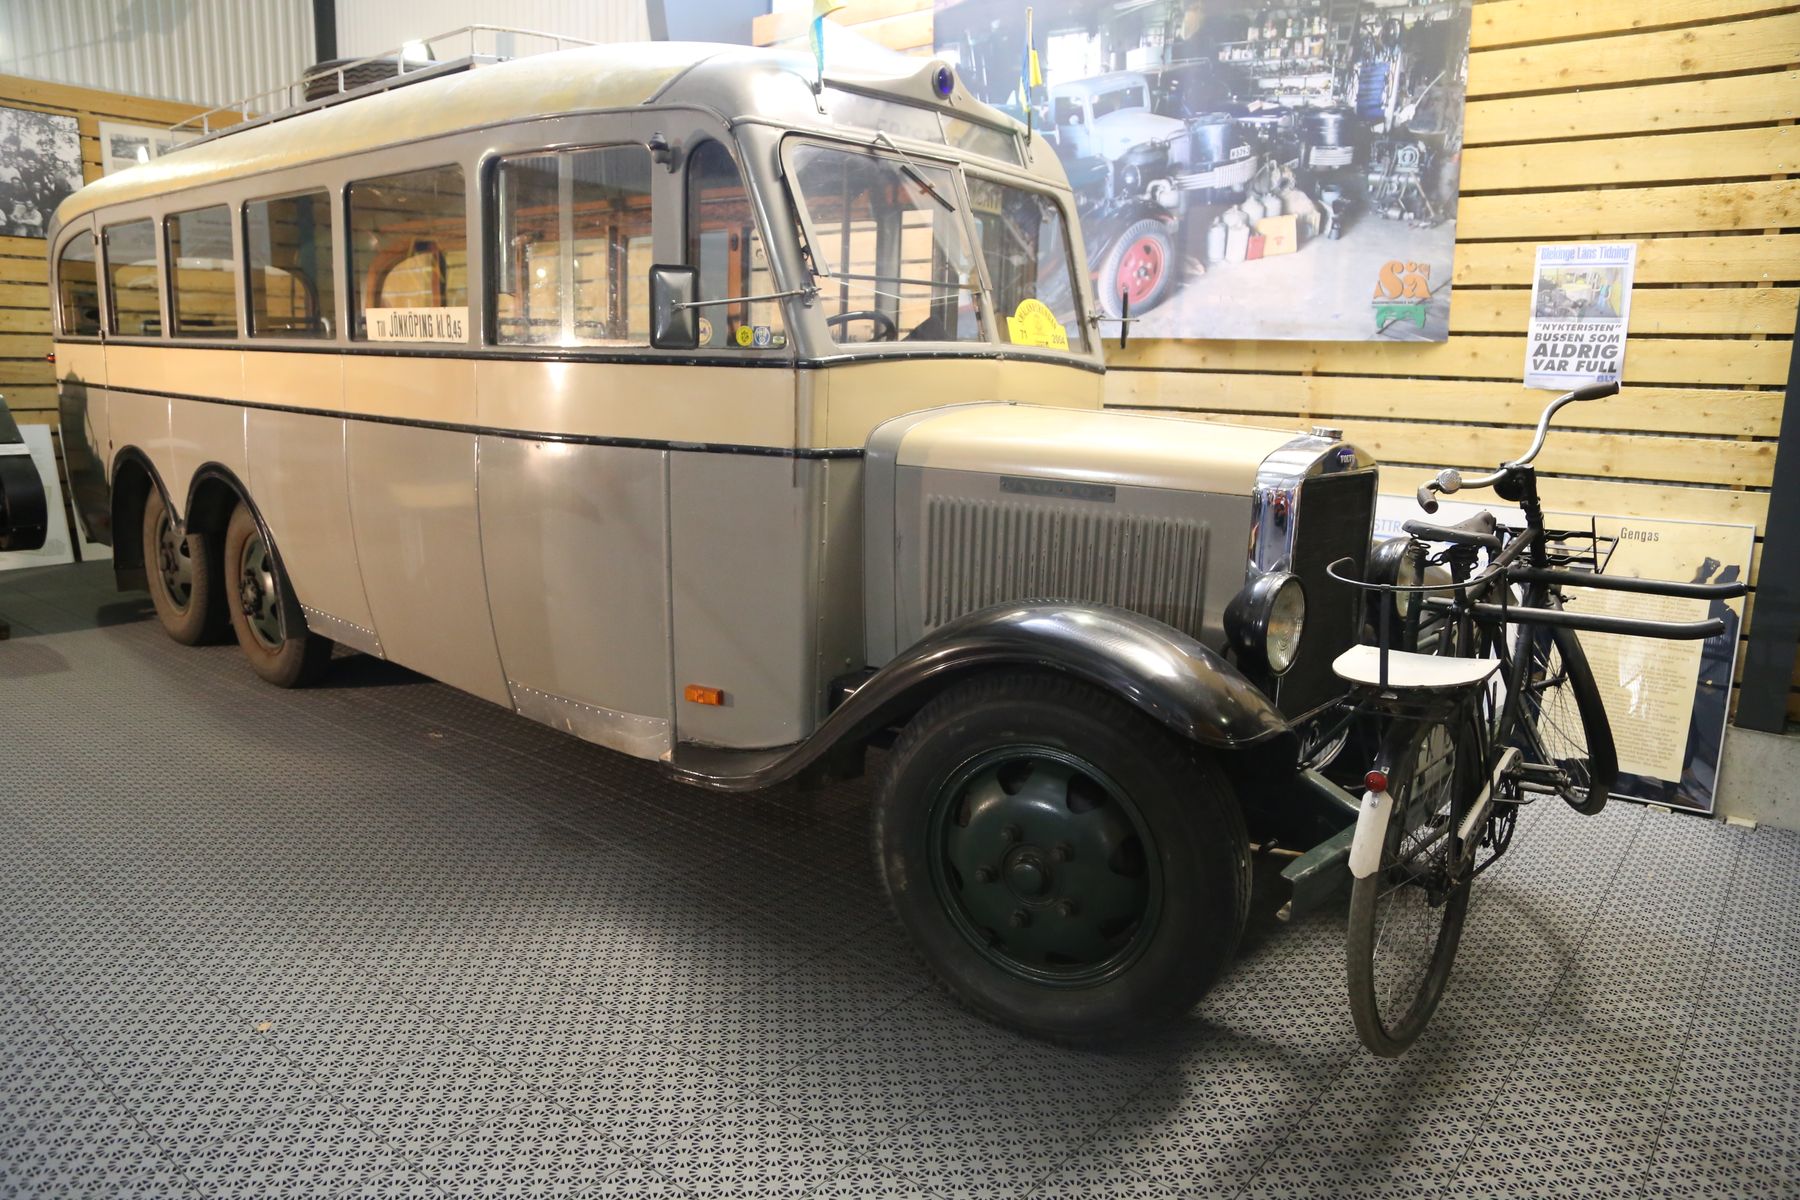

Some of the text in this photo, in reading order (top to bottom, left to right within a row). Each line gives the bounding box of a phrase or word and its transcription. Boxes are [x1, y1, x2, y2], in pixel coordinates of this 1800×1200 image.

[1599, 246, 1630, 260] Tidning
[389, 312, 434, 338] JÖNKÖPING
[1534, 333, 1620, 343] BUSSEN SOM
[1532, 343, 1618, 358] ALDRIG
[1532, 359, 1617, 373] VAR FULL
[1620, 526, 1660, 543] Gengas
